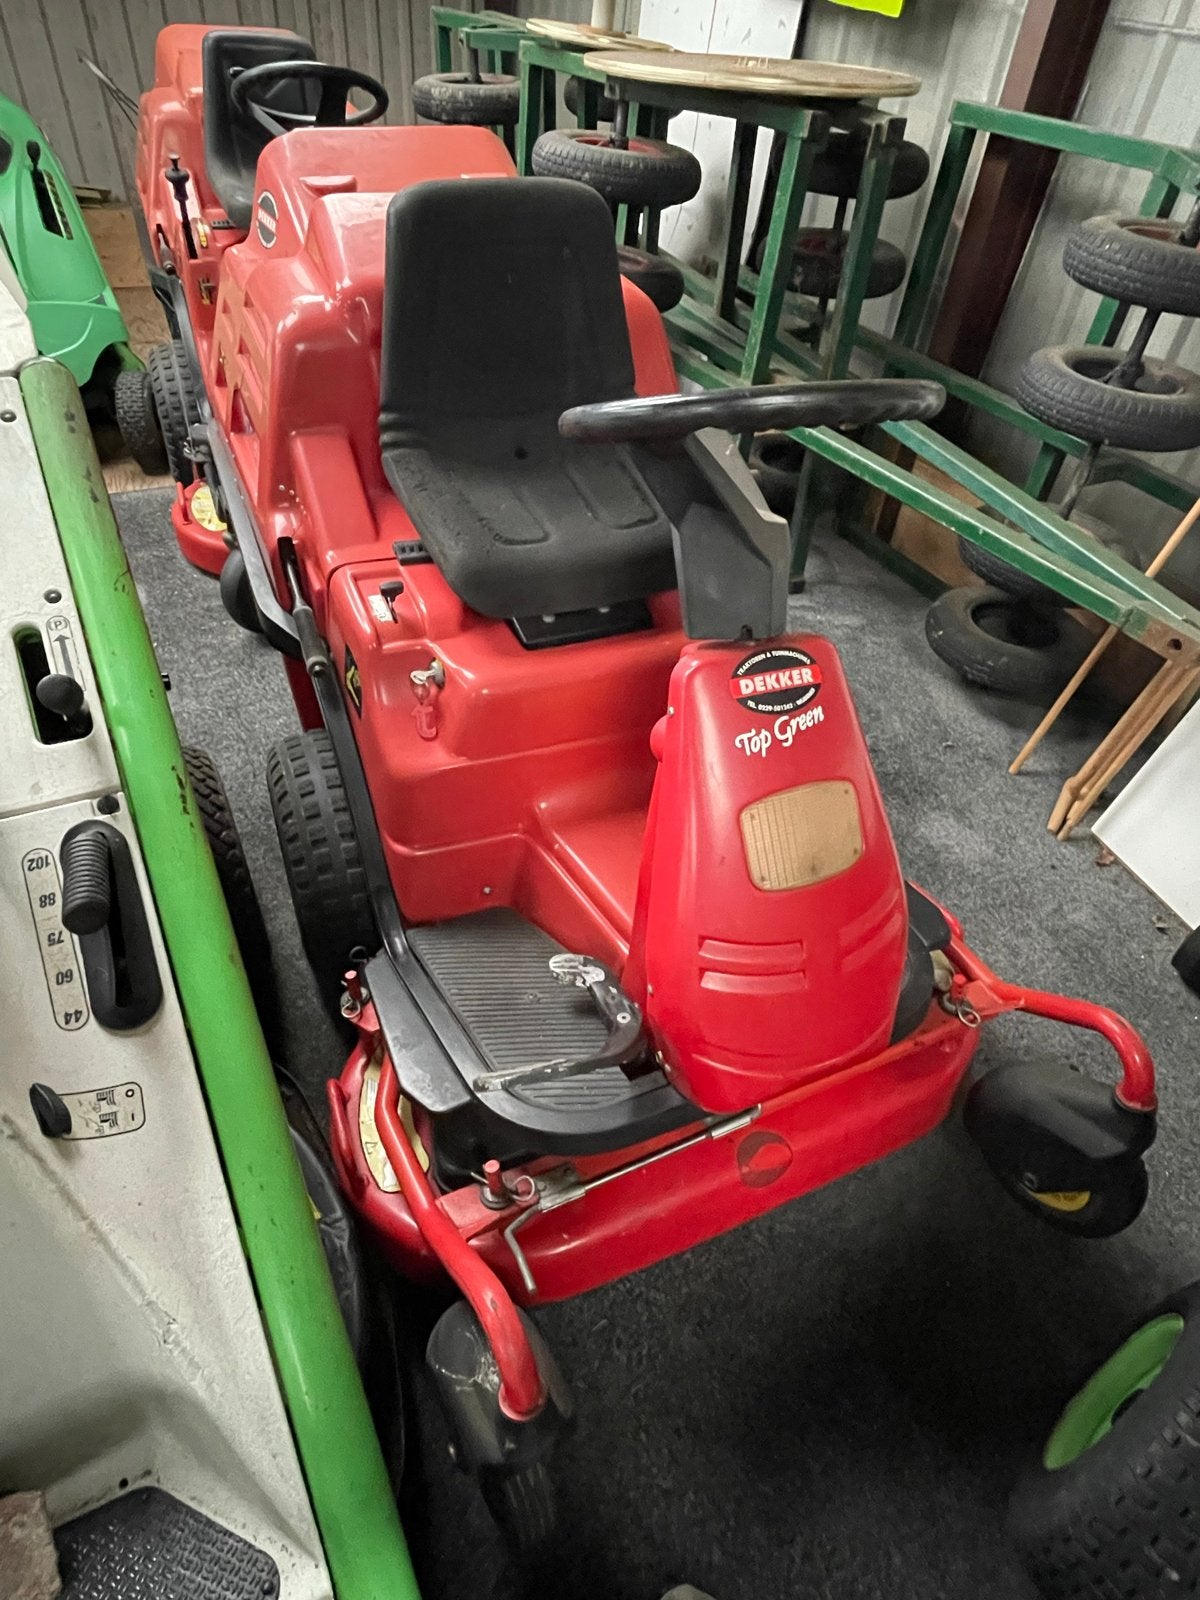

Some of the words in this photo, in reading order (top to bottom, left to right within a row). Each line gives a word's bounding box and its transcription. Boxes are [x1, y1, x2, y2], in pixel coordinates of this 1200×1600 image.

[739, 667, 814, 695] DEKKER
[735, 728, 772, 758] Top
[774, 705, 825, 747] Green
[27, 853, 51, 872] 102
[39, 892, 57, 908] 88
[47, 930, 65, 947] 75
[56, 968, 74, 986] 60
[63, 1008, 83, 1026] 44
